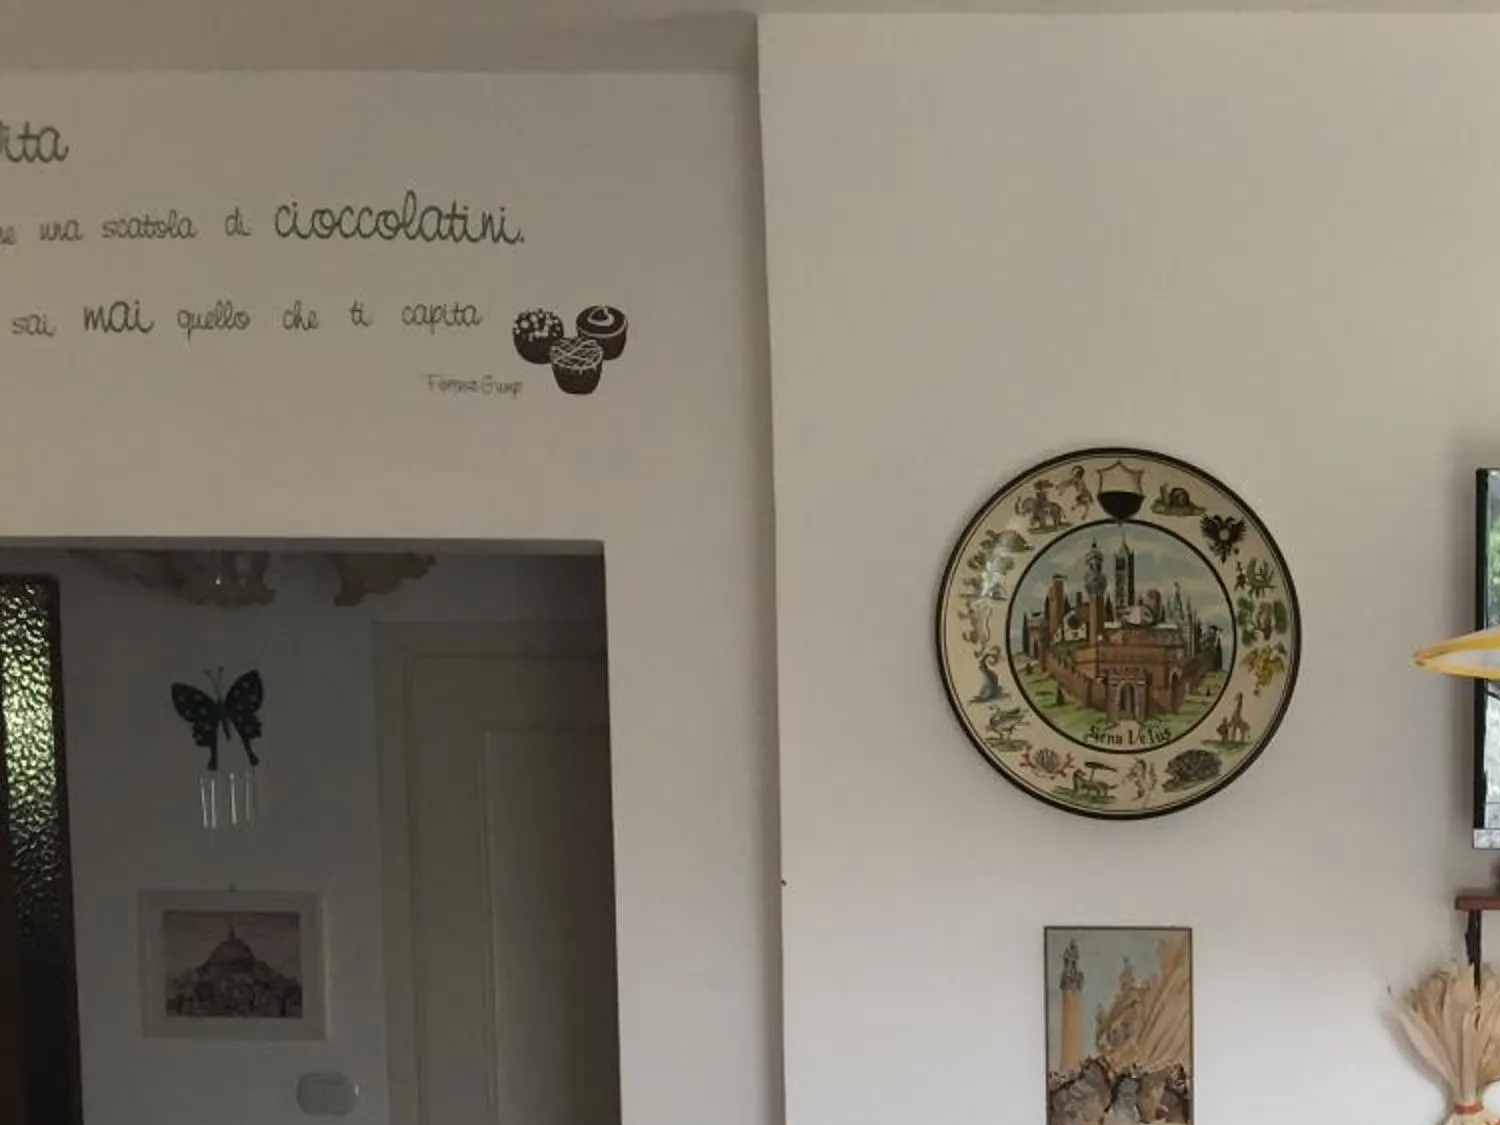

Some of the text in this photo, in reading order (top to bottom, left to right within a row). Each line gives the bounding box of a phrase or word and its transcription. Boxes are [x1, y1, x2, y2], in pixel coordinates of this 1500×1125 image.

[39, 218, 84, 242] una
[101, 208, 199, 240] scatola
[224, 206, 253, 238] di
[275, 189, 526, 244] cioccolatini.
[10, 299, 484, 342] sai mai quello che ti capita
